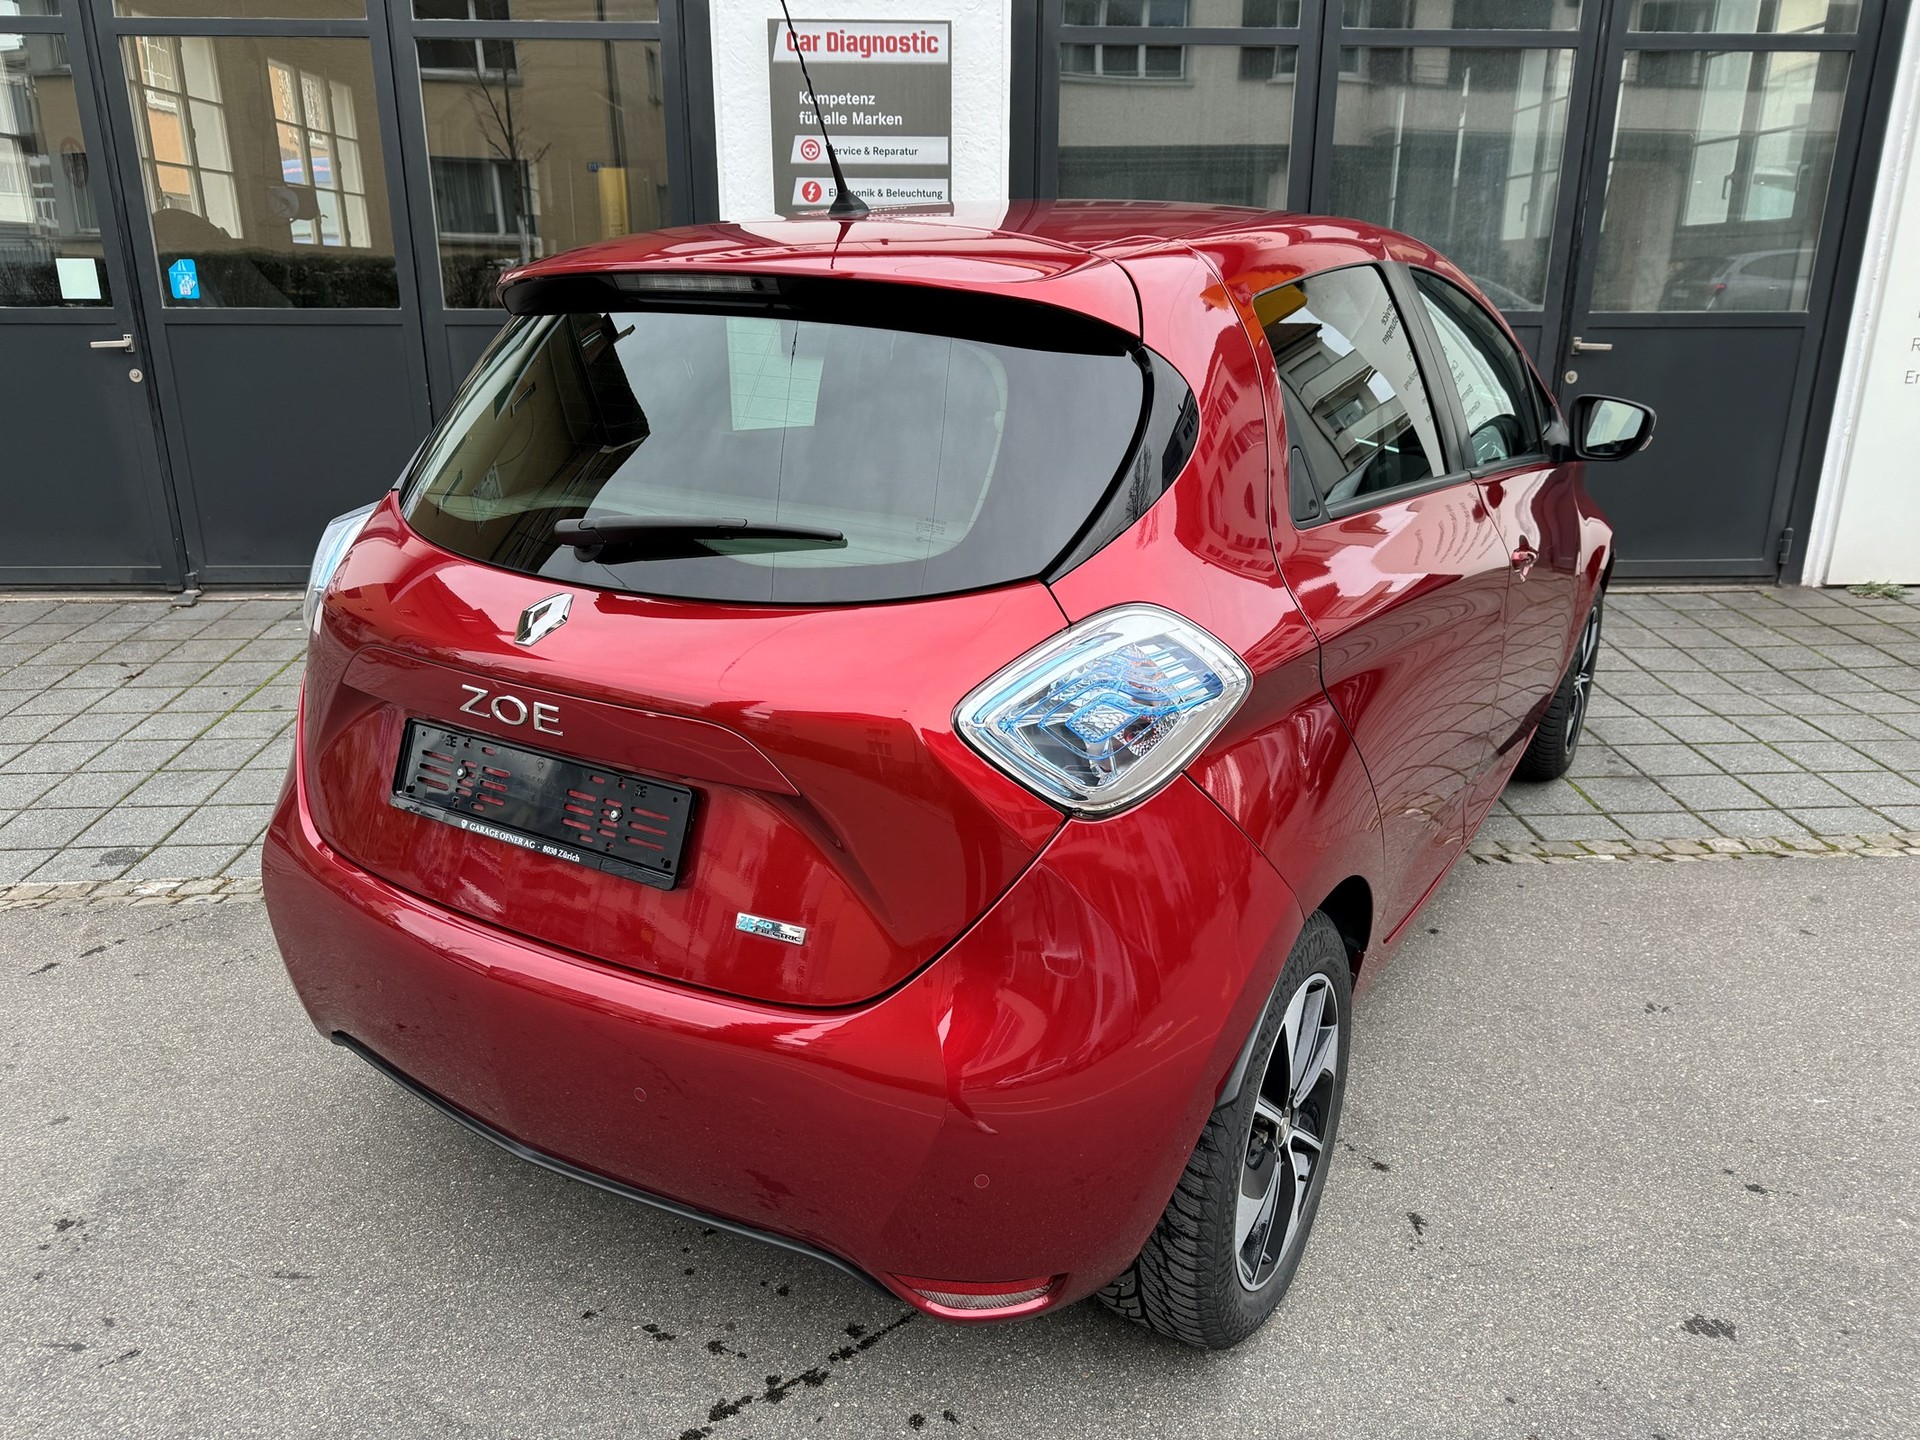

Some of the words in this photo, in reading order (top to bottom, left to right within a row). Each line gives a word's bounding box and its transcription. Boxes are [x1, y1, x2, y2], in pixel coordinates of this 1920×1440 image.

[786, 31, 821, 52] Car
[826, 29, 939, 59] Diagnostic
[799, 91, 876, 108] Kompetenz
[799, 111, 819, 125] für
[824, 112, 848, 126] alle
[852, 112, 903, 126] Marken
[833, 146, 862, 156] ervice
[863, 146, 870, 156] &
[872, 146, 919, 158] Reparatur
[828, 188, 875, 198] Elronik
[877, 188, 884, 198] &
[886, 188, 943, 200] Beleuchtung
[459, 684, 564, 737] ZOE
[469, 823, 500, 839] GARAGE
[499, 831, 527, 846] OFNER
[524, 837, 536, 849] AG
[557, 848, 580, 862] Zürich
